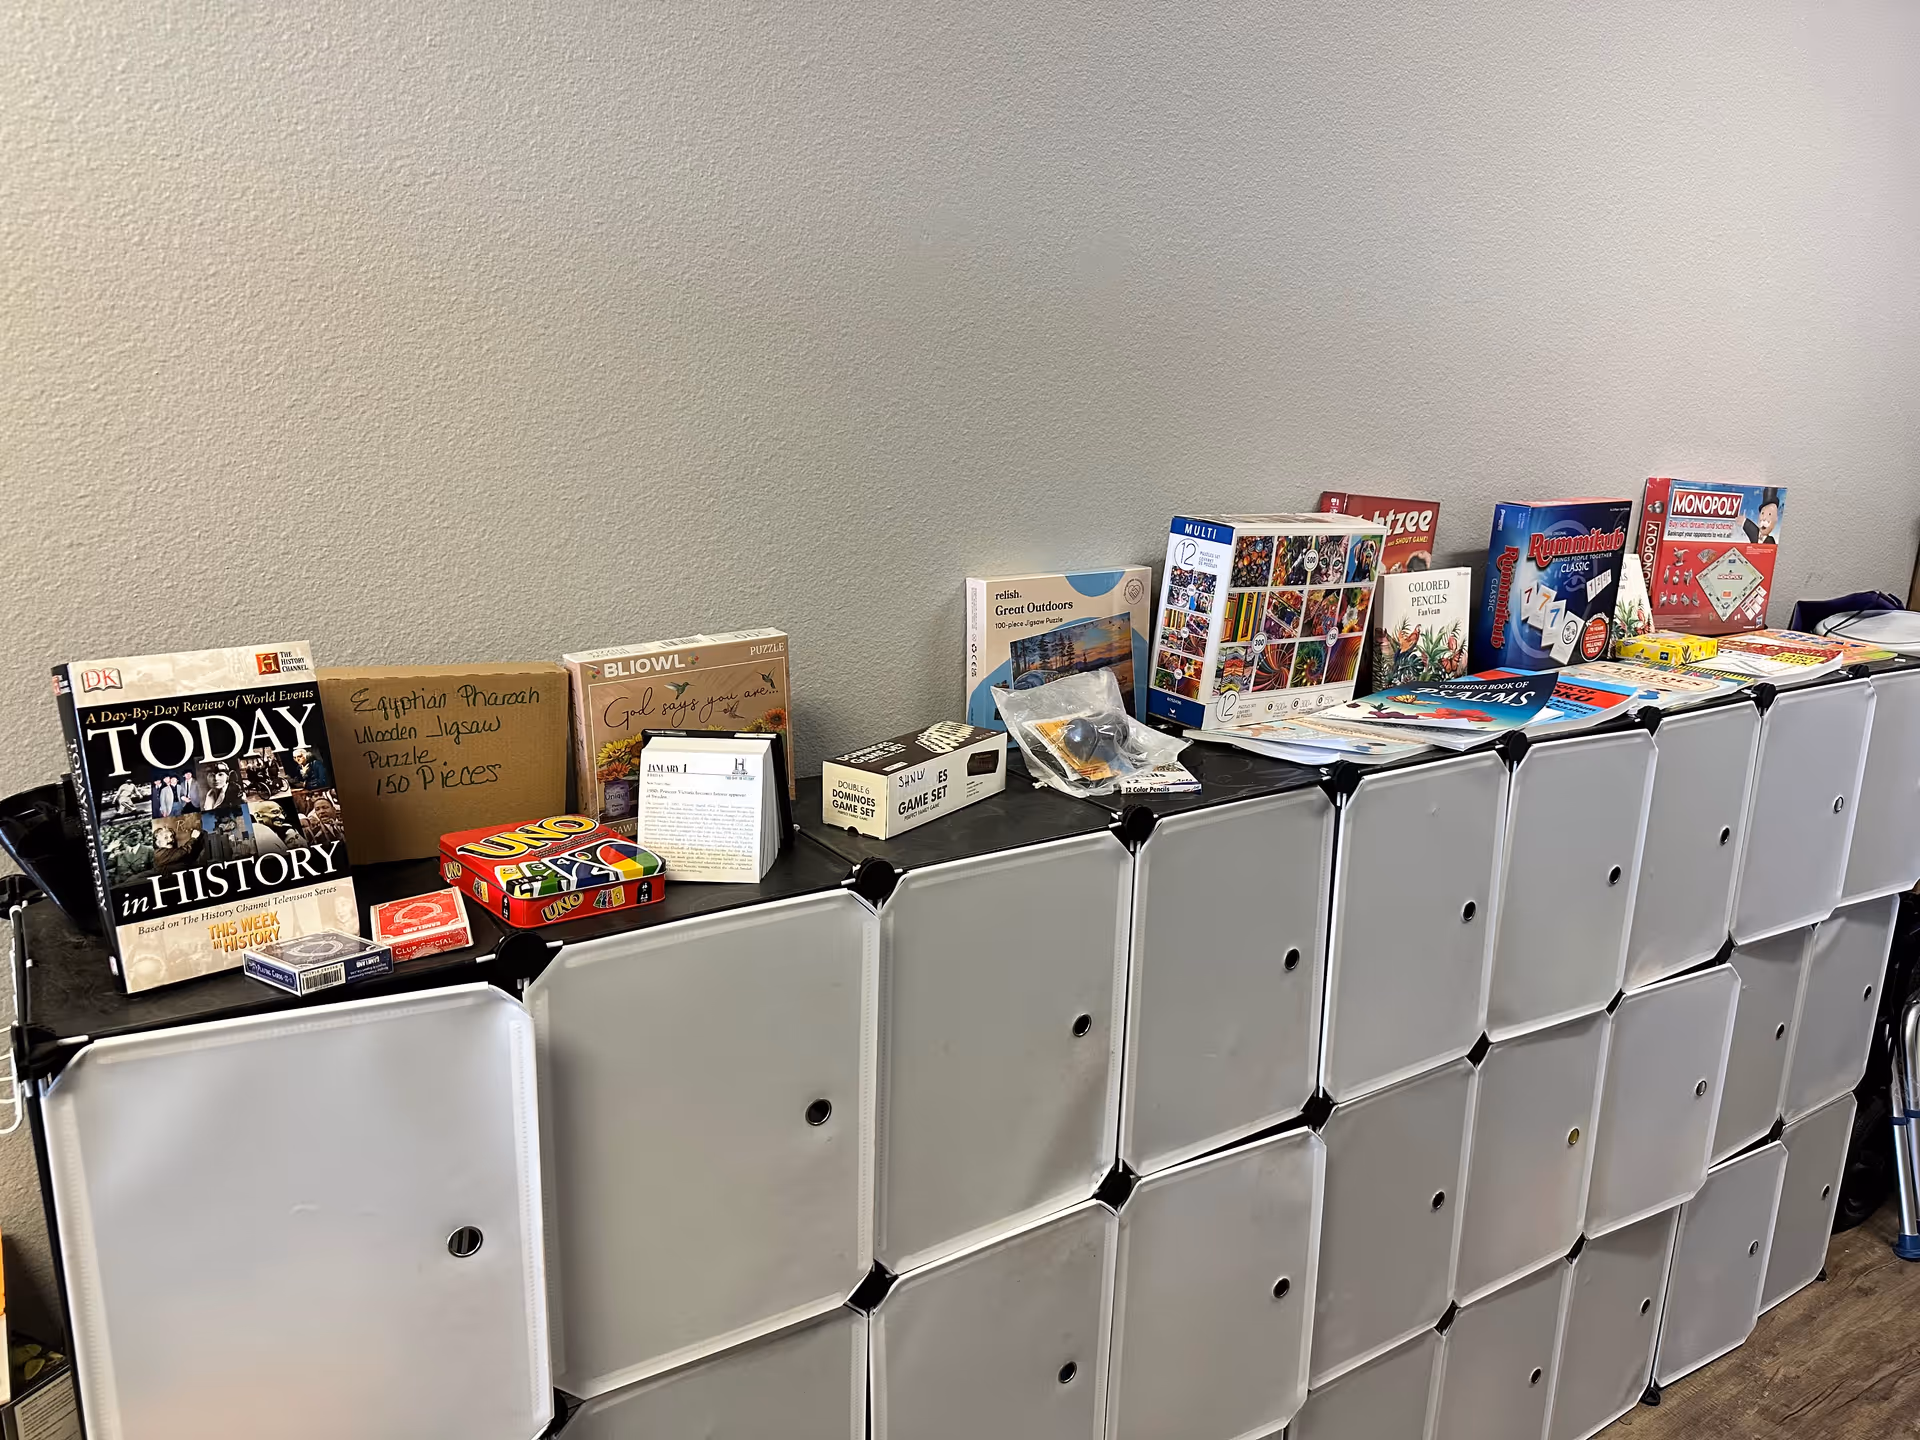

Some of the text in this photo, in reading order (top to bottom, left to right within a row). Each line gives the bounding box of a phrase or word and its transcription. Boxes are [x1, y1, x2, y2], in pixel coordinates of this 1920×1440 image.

[1673, 494, 1741, 516] MONOPOLY
[1184, 524, 1217, 540] MULTI
[1395, 537, 1412, 545] SHOUT
[1180, 542, 1197, 567] 12
[1528, 526, 1625, 567] Rummikub
[1590, 552, 1612, 560] TOGETHER
[1306, 556, 1316, 564] 500
[1561, 562, 1590, 573] CLASSIC
[994, 589, 1022, 600] relish.
[1408, 580, 1450, 593] COLORED
[1488, 578, 1498, 612] CLASSIC
[1411, 594, 1448, 607] PENCILS
[1491, 545, 1520, 649] Rummikub
[994, 600, 1074, 616] Great Outdoors
[1550, 608, 1560, 628] 7
[994, 616, 1063, 630] 100-piece Jigsaw Puzzle
[750, 642, 785, 656] PUZZLE
[1254, 638, 1265, 647] 300
[280, 657, 305, 666] HISTORY
[281, 663, 309, 672] CHANNEL
[603, 653, 686, 678] BLIOWL
[85, 669, 120, 690] DK
[1439, 680, 1530, 690] COLORING BOOK OF
[86, 688, 314, 724] A Day-By-Day Review of World Events
[350, 687, 448, 720] Egyptian
[1220, 693, 1236, 717] 12
[1410, 687, 1536, 706] PSALMS
[1556, 699, 1596, 712] Medium
[604, 686, 656, 730] God
[660, 698, 700, 728] says
[698, 692, 738, 724] you
[1550, 703, 1588, 714] Puzzles
[87, 702, 316, 778] TODAY
[354, 715, 502, 745] Wooden Jigsaw
[363, 746, 437, 769] Puzzle
[376, 761, 502, 796] 150 Pieces
[647, 764, 687, 773] JANUARY 1
[838, 780, 870, 794] DOUBLE 6
[832, 788, 876, 808] DOMINOES
[898, 792, 928, 815] GAME
[931, 784, 948, 802] SET
[832, 799, 876, 818] GAME SET
[456, 815, 600, 860] UNO
[123, 840, 341, 917] in HISTORY
[443, 860, 462, 880] UNO
[138, 886, 338, 936] Based on The History Channel Television Series
[540, 891, 584, 923] UNO
[208, 911, 280, 940] THIS WEEK
[212, 926, 282, 953] IN HISTORY
